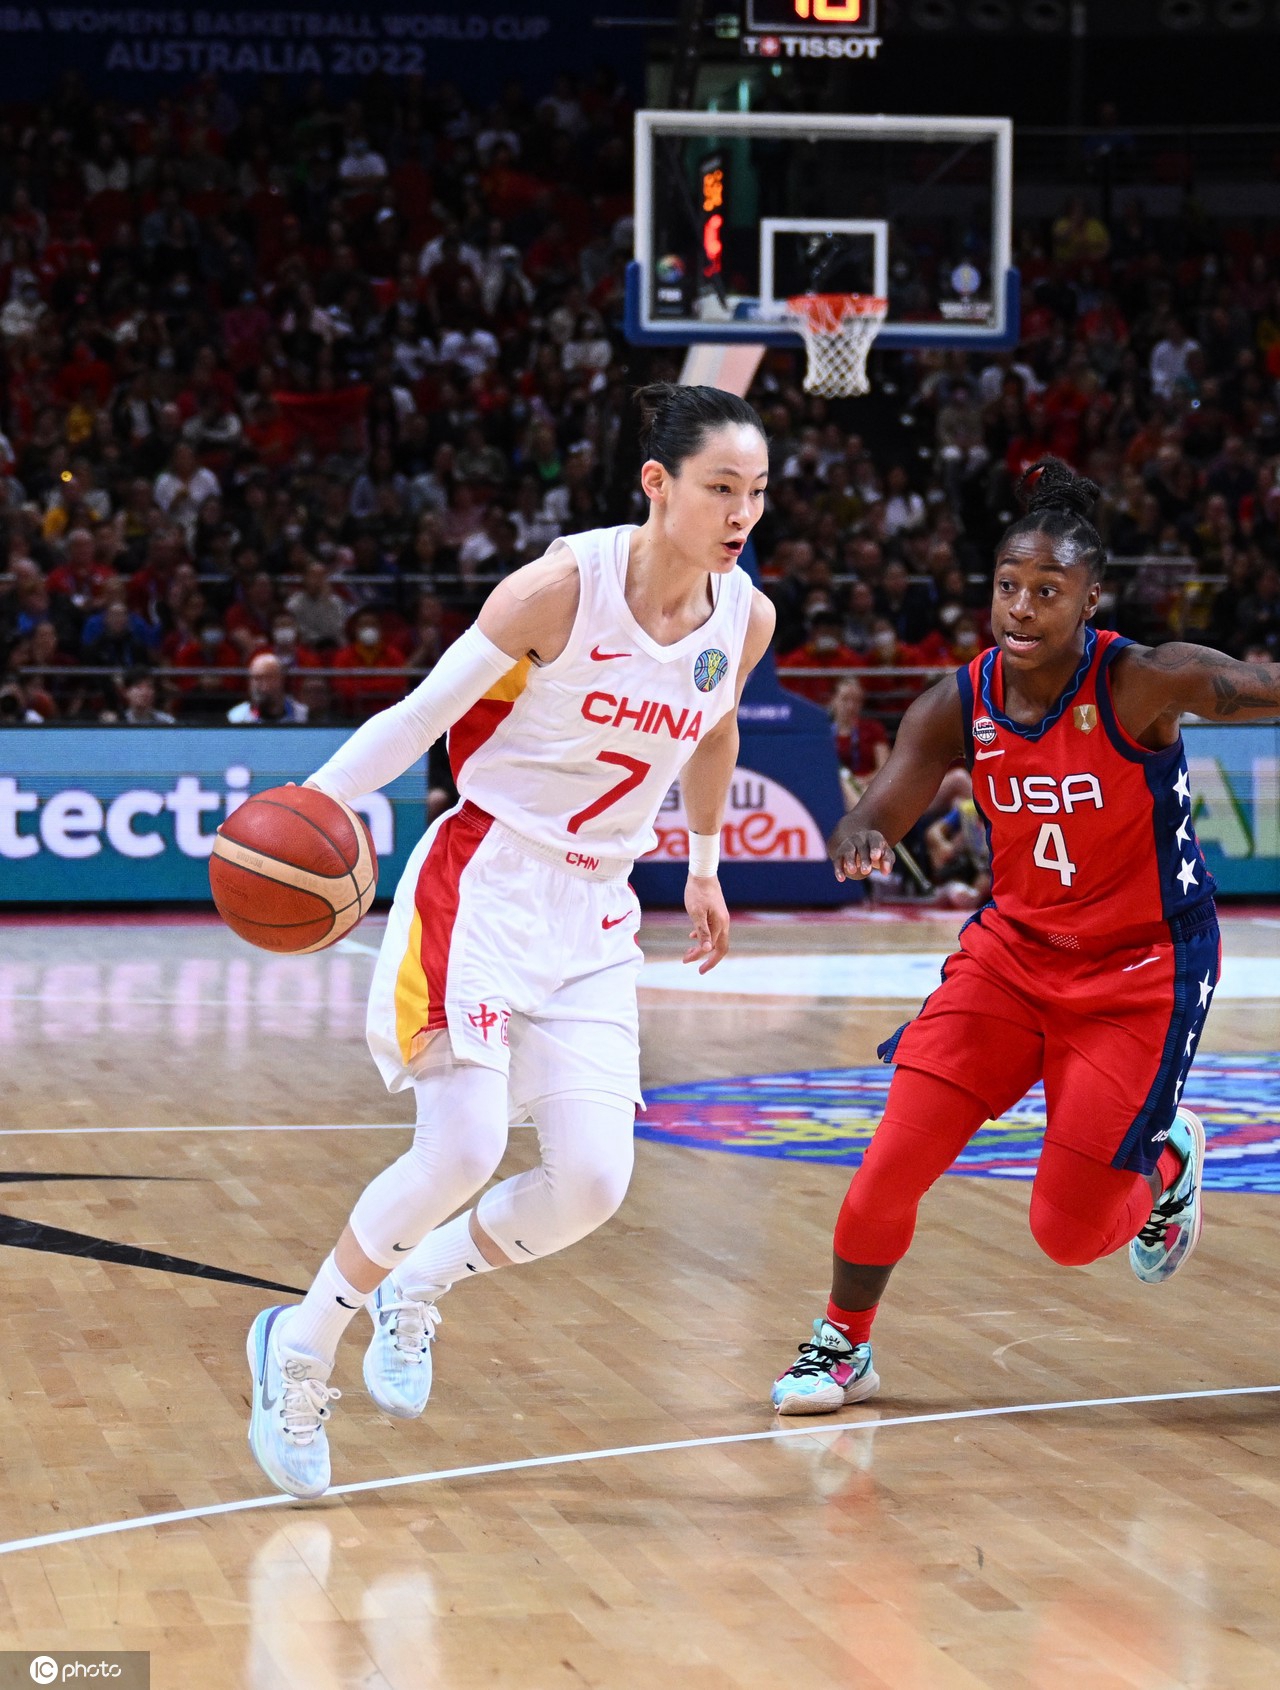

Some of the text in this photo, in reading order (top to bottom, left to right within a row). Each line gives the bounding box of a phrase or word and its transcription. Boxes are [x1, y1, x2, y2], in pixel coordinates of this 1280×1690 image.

[193, 10, 377, 40] BASKETBALL
[382, 14, 488, 40] WORLD
[492, 16, 550, 41] CUP
[106, 41, 427, 75] AUSTRALIA 2022
[781, 37, 882, 59] TISSOT
[581, 690, 703, 741] CHINA
[567, 750, 651, 835] 7
[987, 772, 1104, 814] USA
[565, 851, 600, 871] CHN
[1033, 822, 1077, 887] 4
